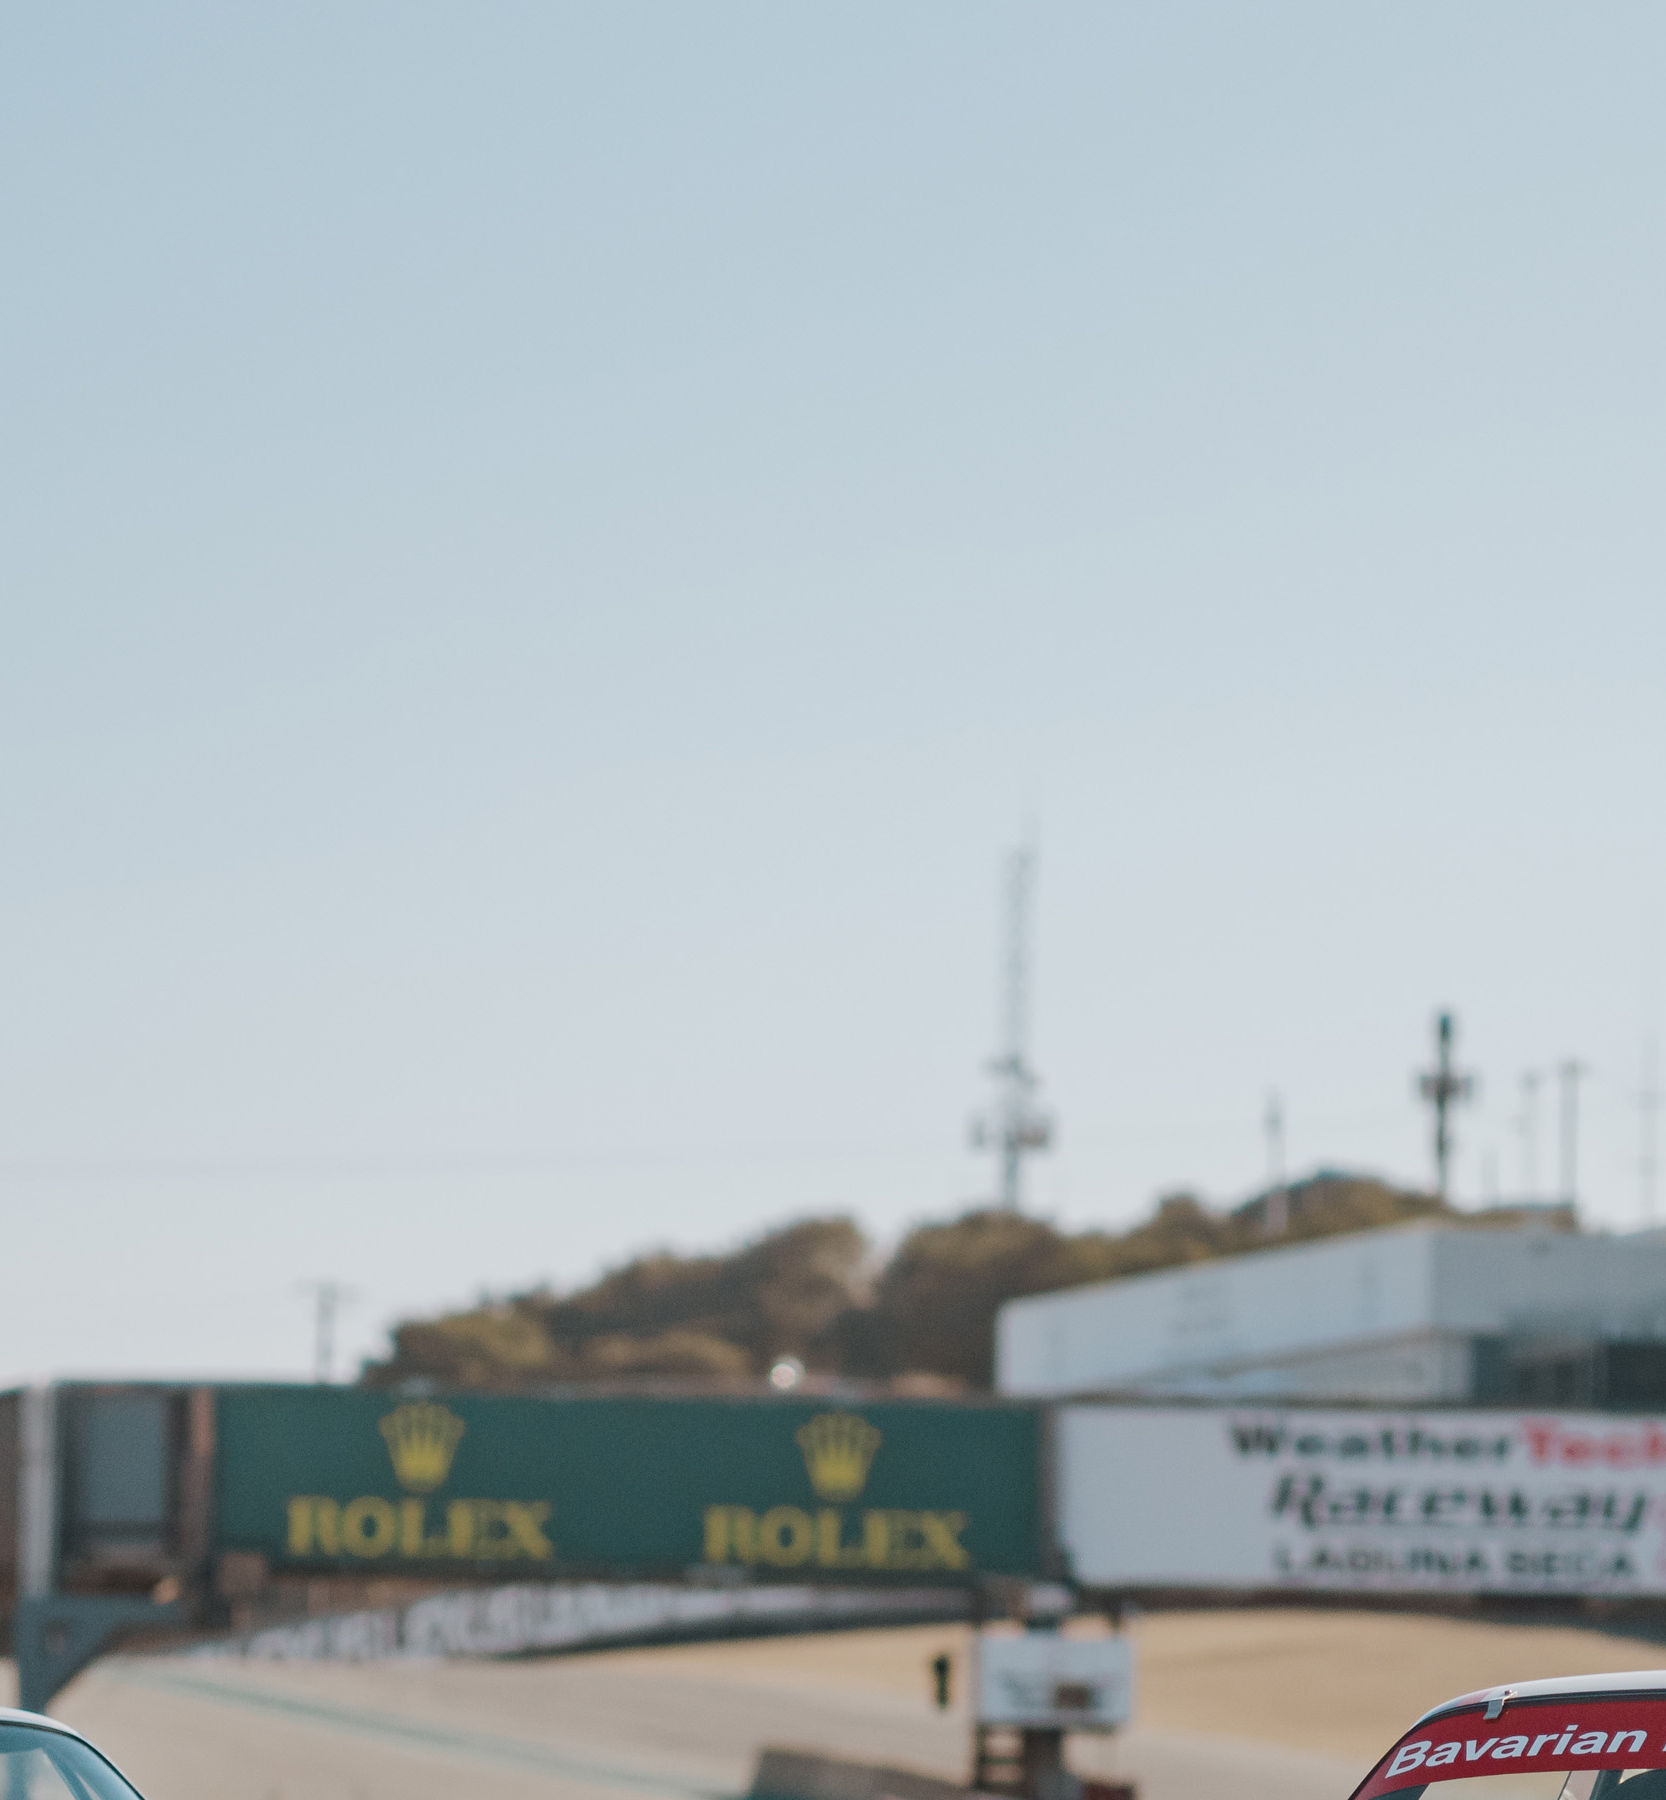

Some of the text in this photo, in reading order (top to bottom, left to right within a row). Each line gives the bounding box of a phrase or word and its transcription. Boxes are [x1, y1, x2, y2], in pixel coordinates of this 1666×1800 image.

[286, 1495, 555, 1562] ROLEX
[702, 1503, 970, 1570] ROLEX
[1384, 1724, 1648, 1779] Bavarian
